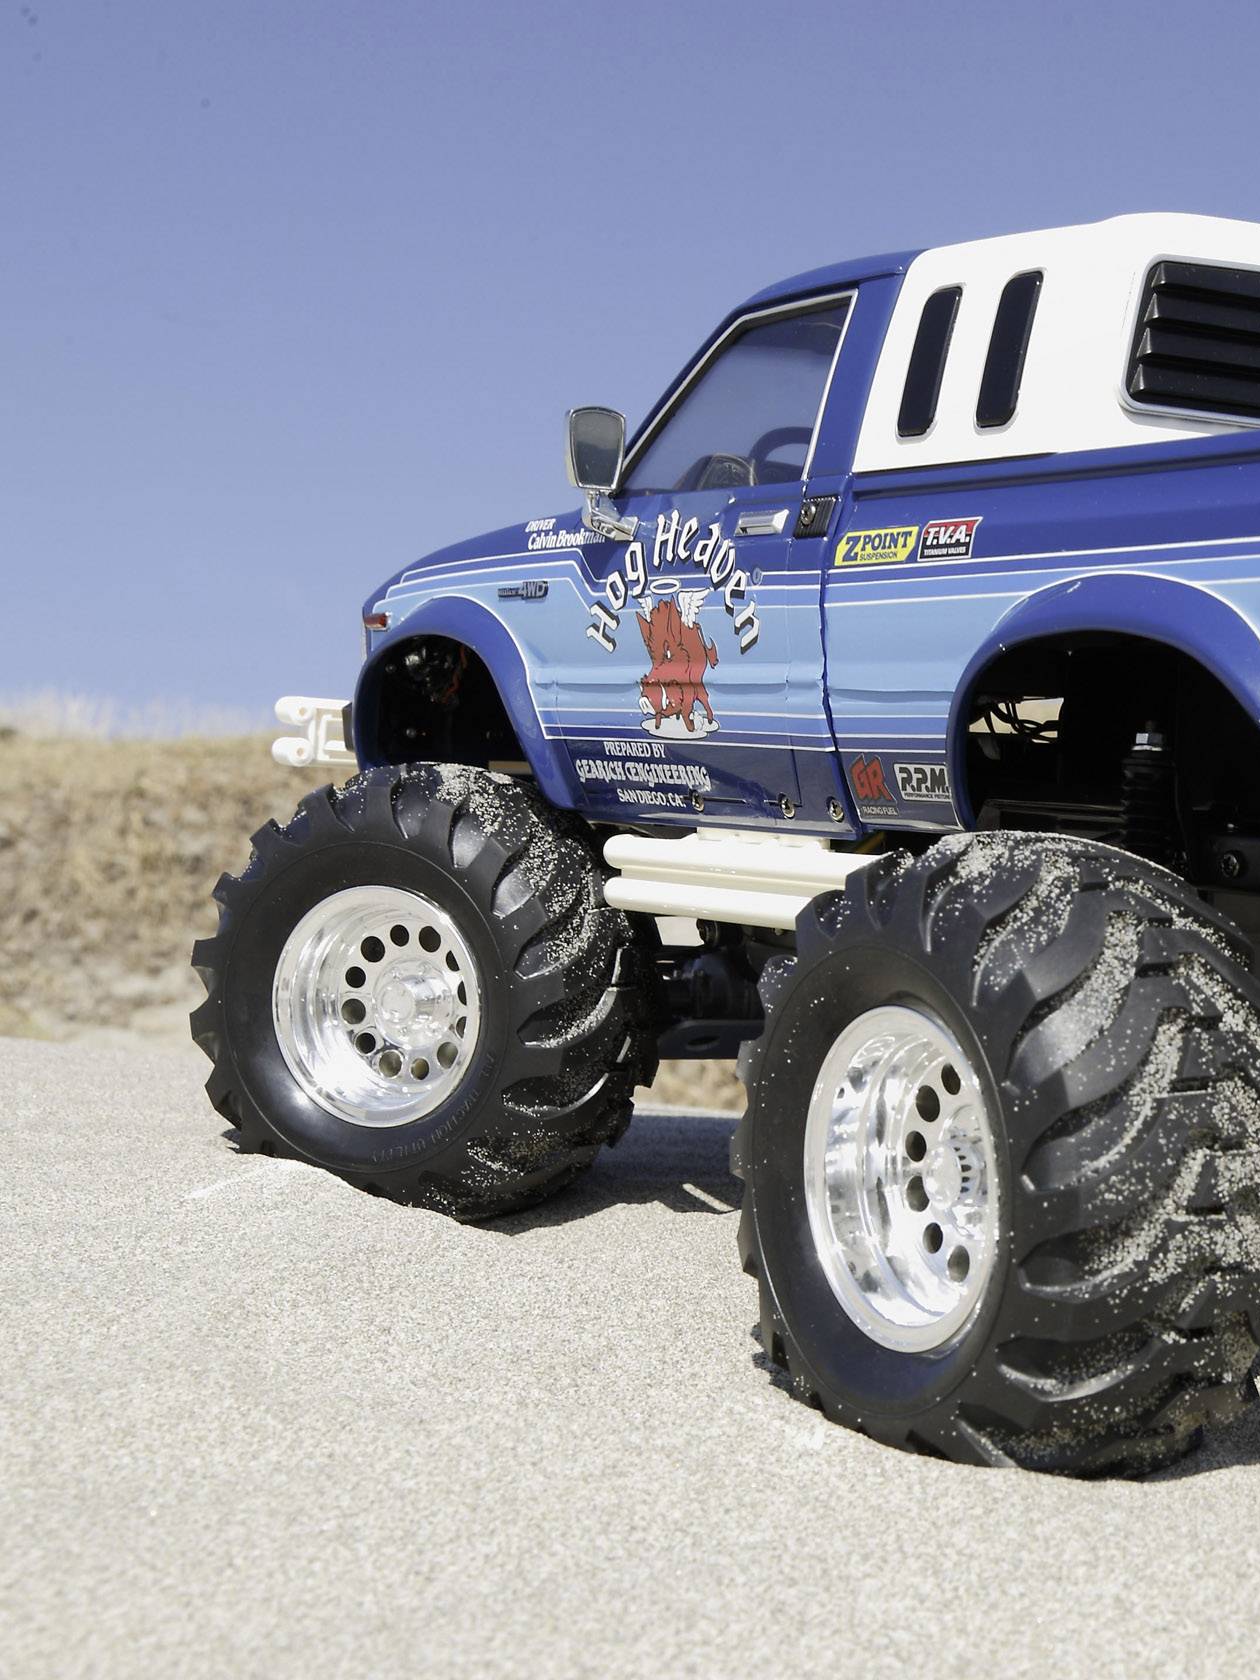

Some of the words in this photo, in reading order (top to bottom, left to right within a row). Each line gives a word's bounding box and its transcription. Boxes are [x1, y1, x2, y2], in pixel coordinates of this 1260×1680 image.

[525, 518, 556, 532] DRIVER
[925, 525, 969, 546] T.V.A.
[859, 550, 898, 562] SUSPENSION
[519, 580, 547, 598] 4WD
[586, 540, 649, 653] Hog
[652, 509, 760, 655] Heaven
[604, 741, 651, 757] PREPARED
[652, 743, 667, 759] BY
[616, 788, 638, 803] SAN
